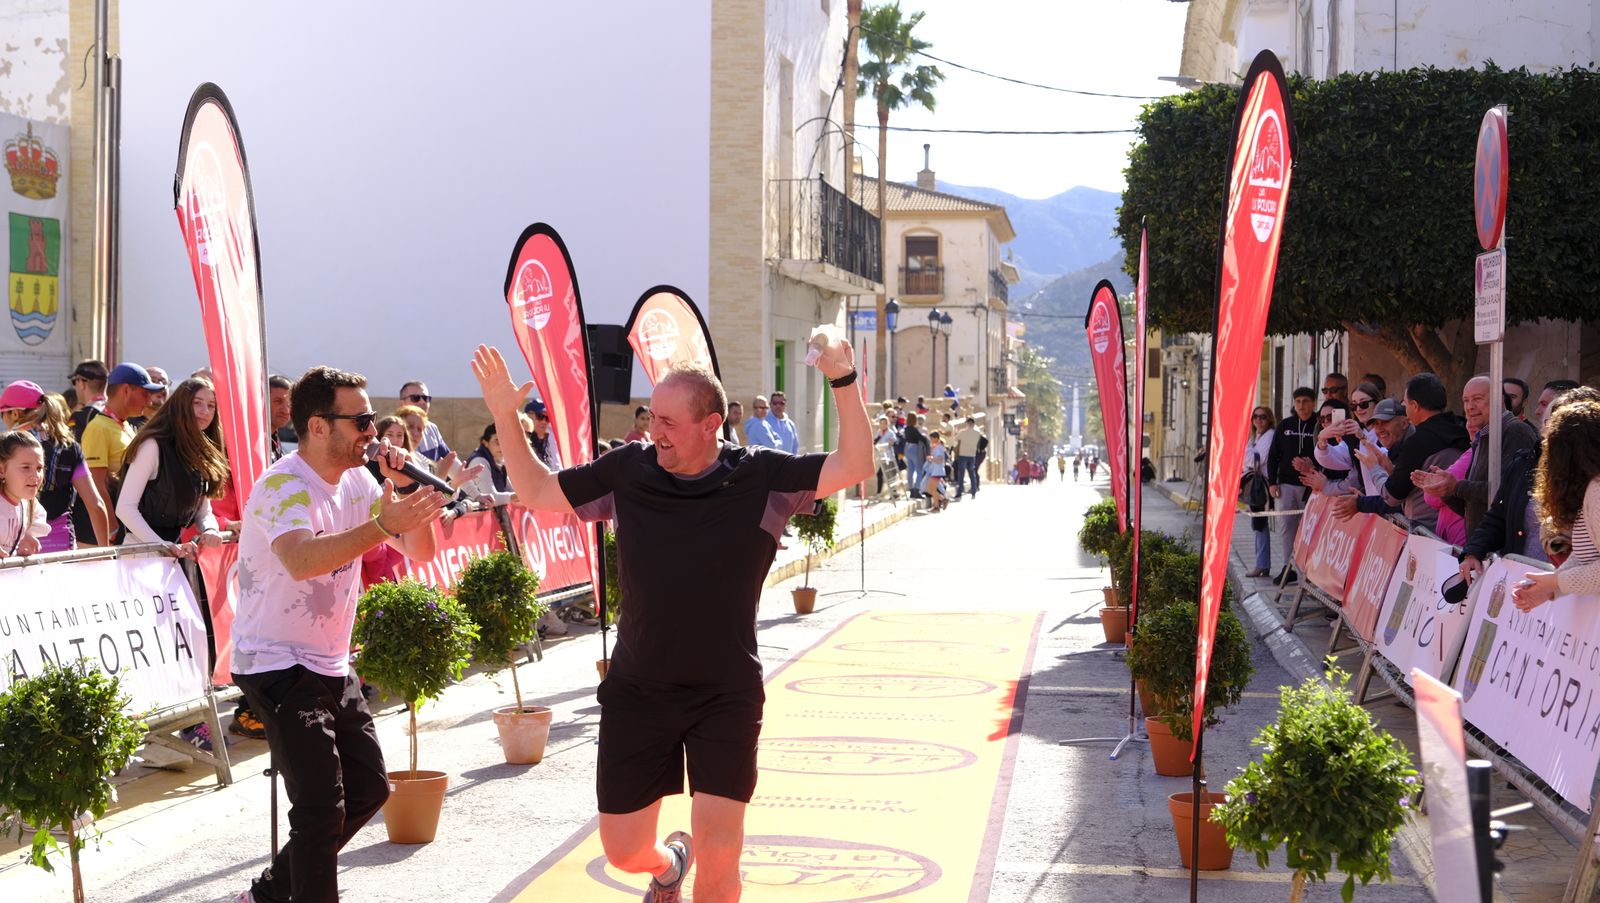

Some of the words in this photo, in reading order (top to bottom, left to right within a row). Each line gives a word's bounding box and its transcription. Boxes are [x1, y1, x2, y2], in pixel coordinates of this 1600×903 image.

[0, 598, 145, 637] UNTAMIENTO
[152, 593, 180, 614] DE
[11, 621, 193, 685] ANTORIA
